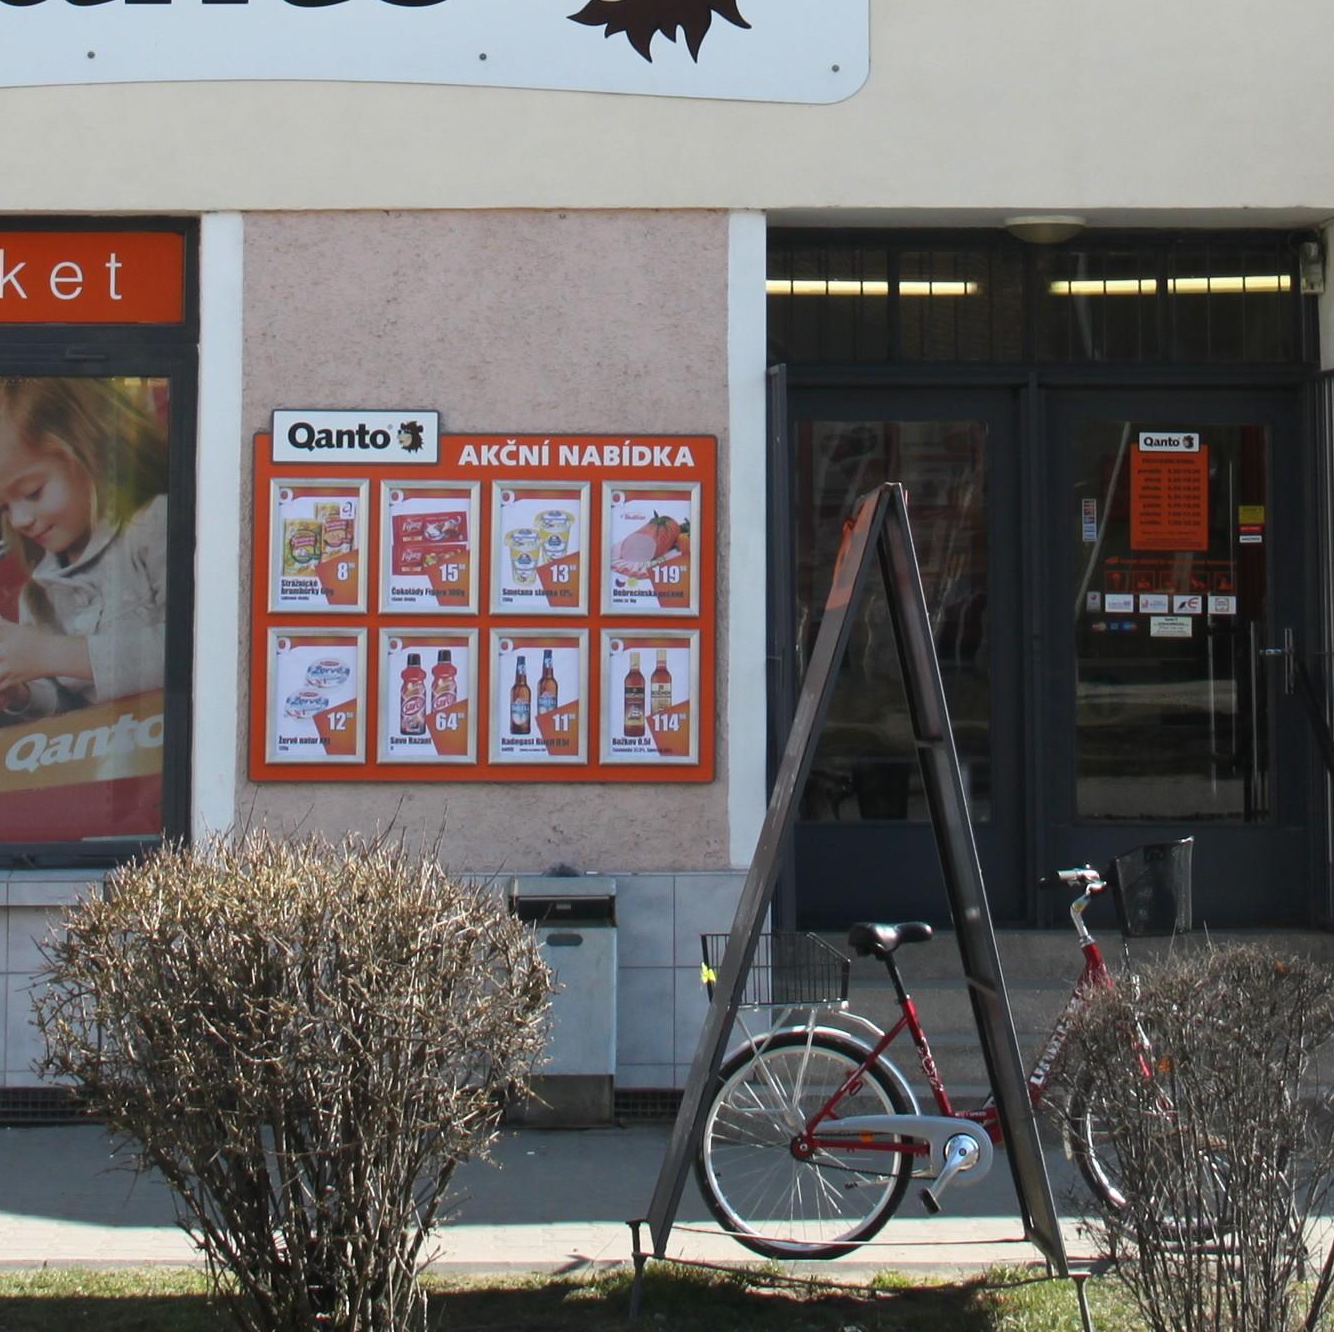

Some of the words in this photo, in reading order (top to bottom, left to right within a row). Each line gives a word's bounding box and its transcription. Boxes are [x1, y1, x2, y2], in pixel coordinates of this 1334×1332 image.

[1143, 435, 1181, 448] Qanto
[458, 440, 551, 467] AKČNÍ
[558, 440, 695, 467] NABÍDKA
[337, 562, 349, 581] 8
[439, 563, 460, 582] 15
[550, 564, 570, 583] 13
[652, 566, 680, 584] 119
[328, 712, 347, 731] 12
[435, 712, 459, 731] 64
[552, 714, 569, 732] 11
[652, 713, 680, 732] 114
[5, 713, 164, 772] Qanto
